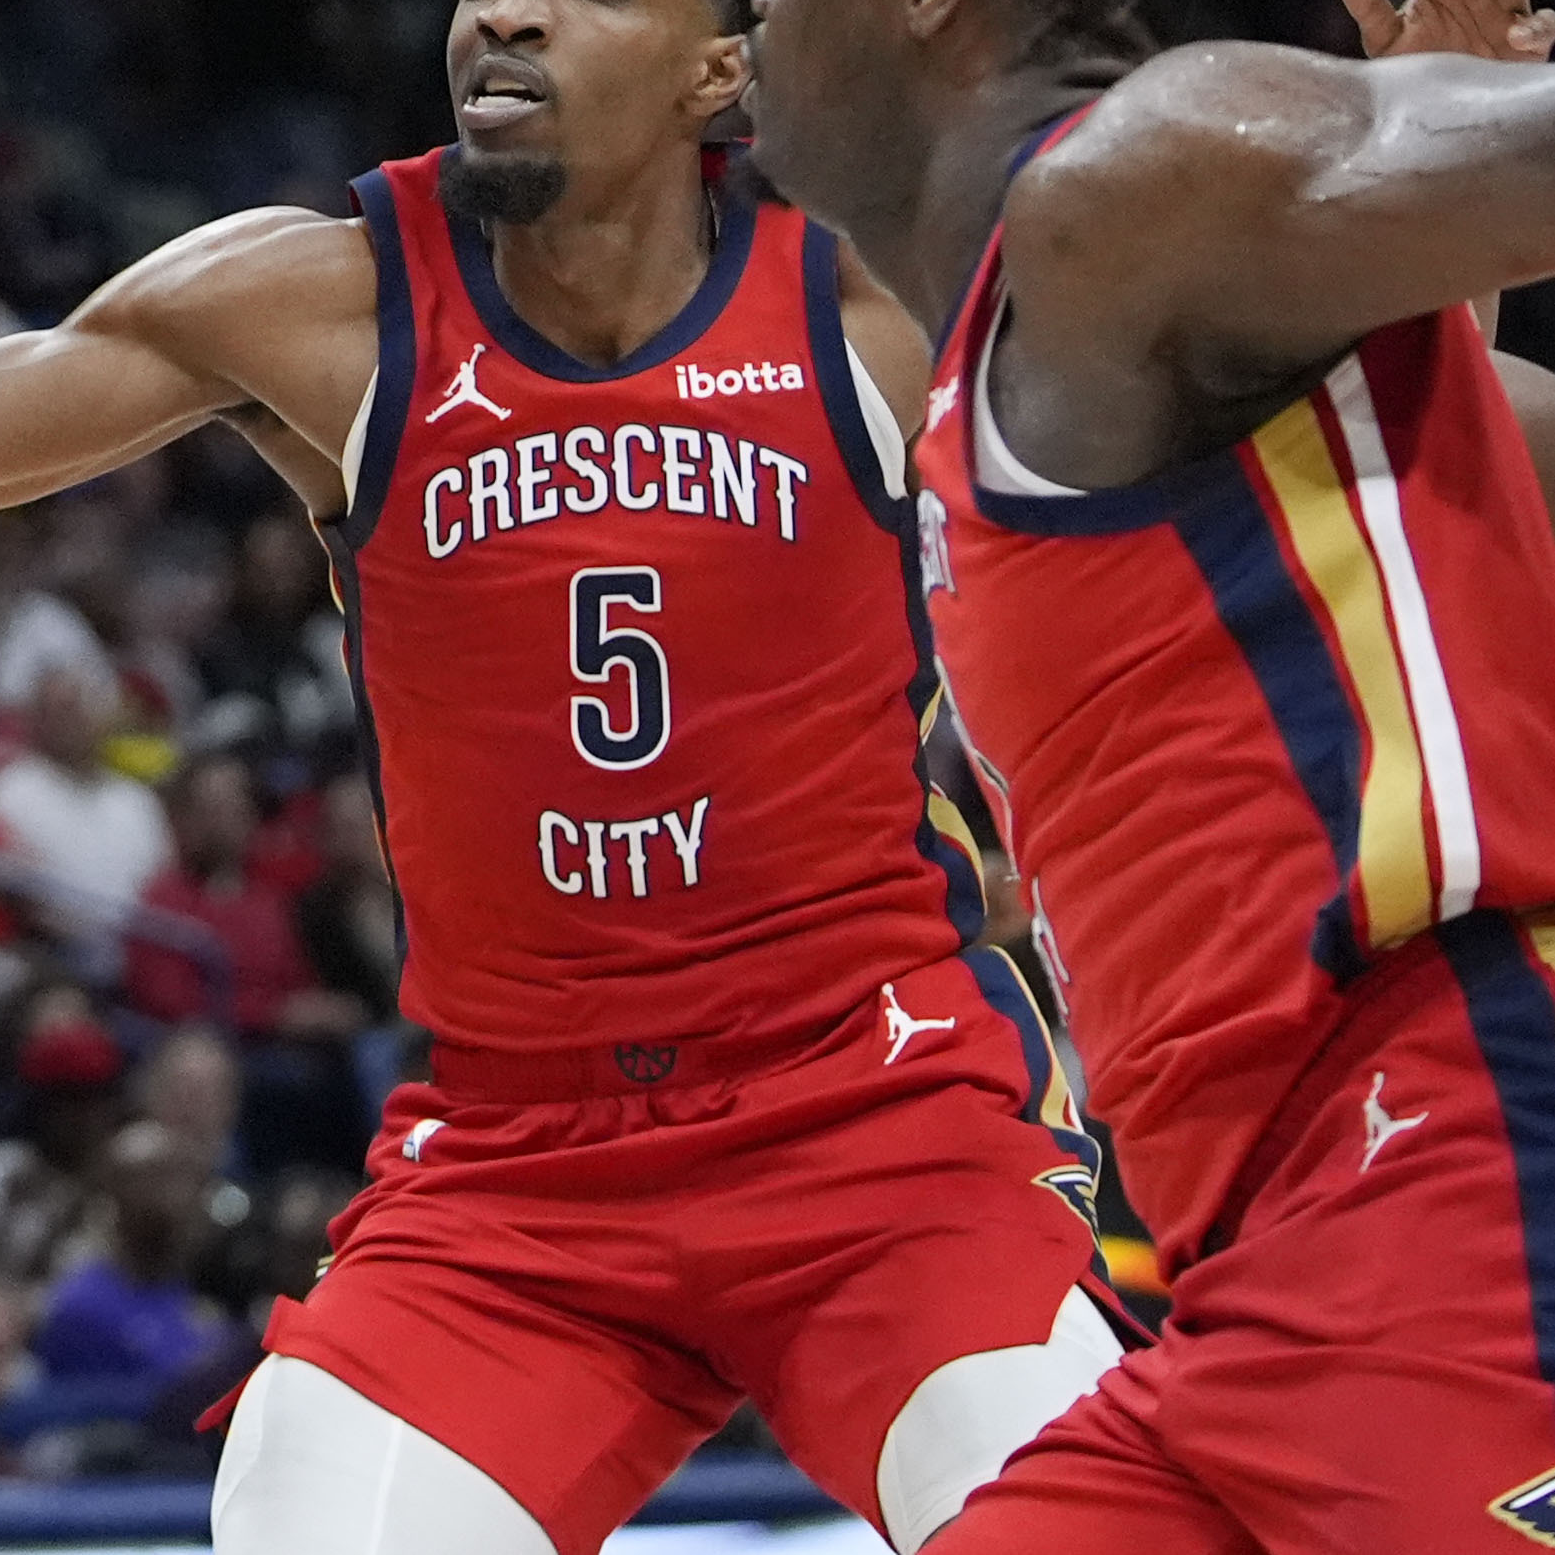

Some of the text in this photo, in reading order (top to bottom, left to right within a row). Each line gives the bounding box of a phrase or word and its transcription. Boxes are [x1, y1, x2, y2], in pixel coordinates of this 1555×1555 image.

[675, 360, 804, 400] ibotta
[422, 423, 809, 560] CRESCENT
[568, 565, 671, 771] 5
[537, 796, 710, 899] CITY
